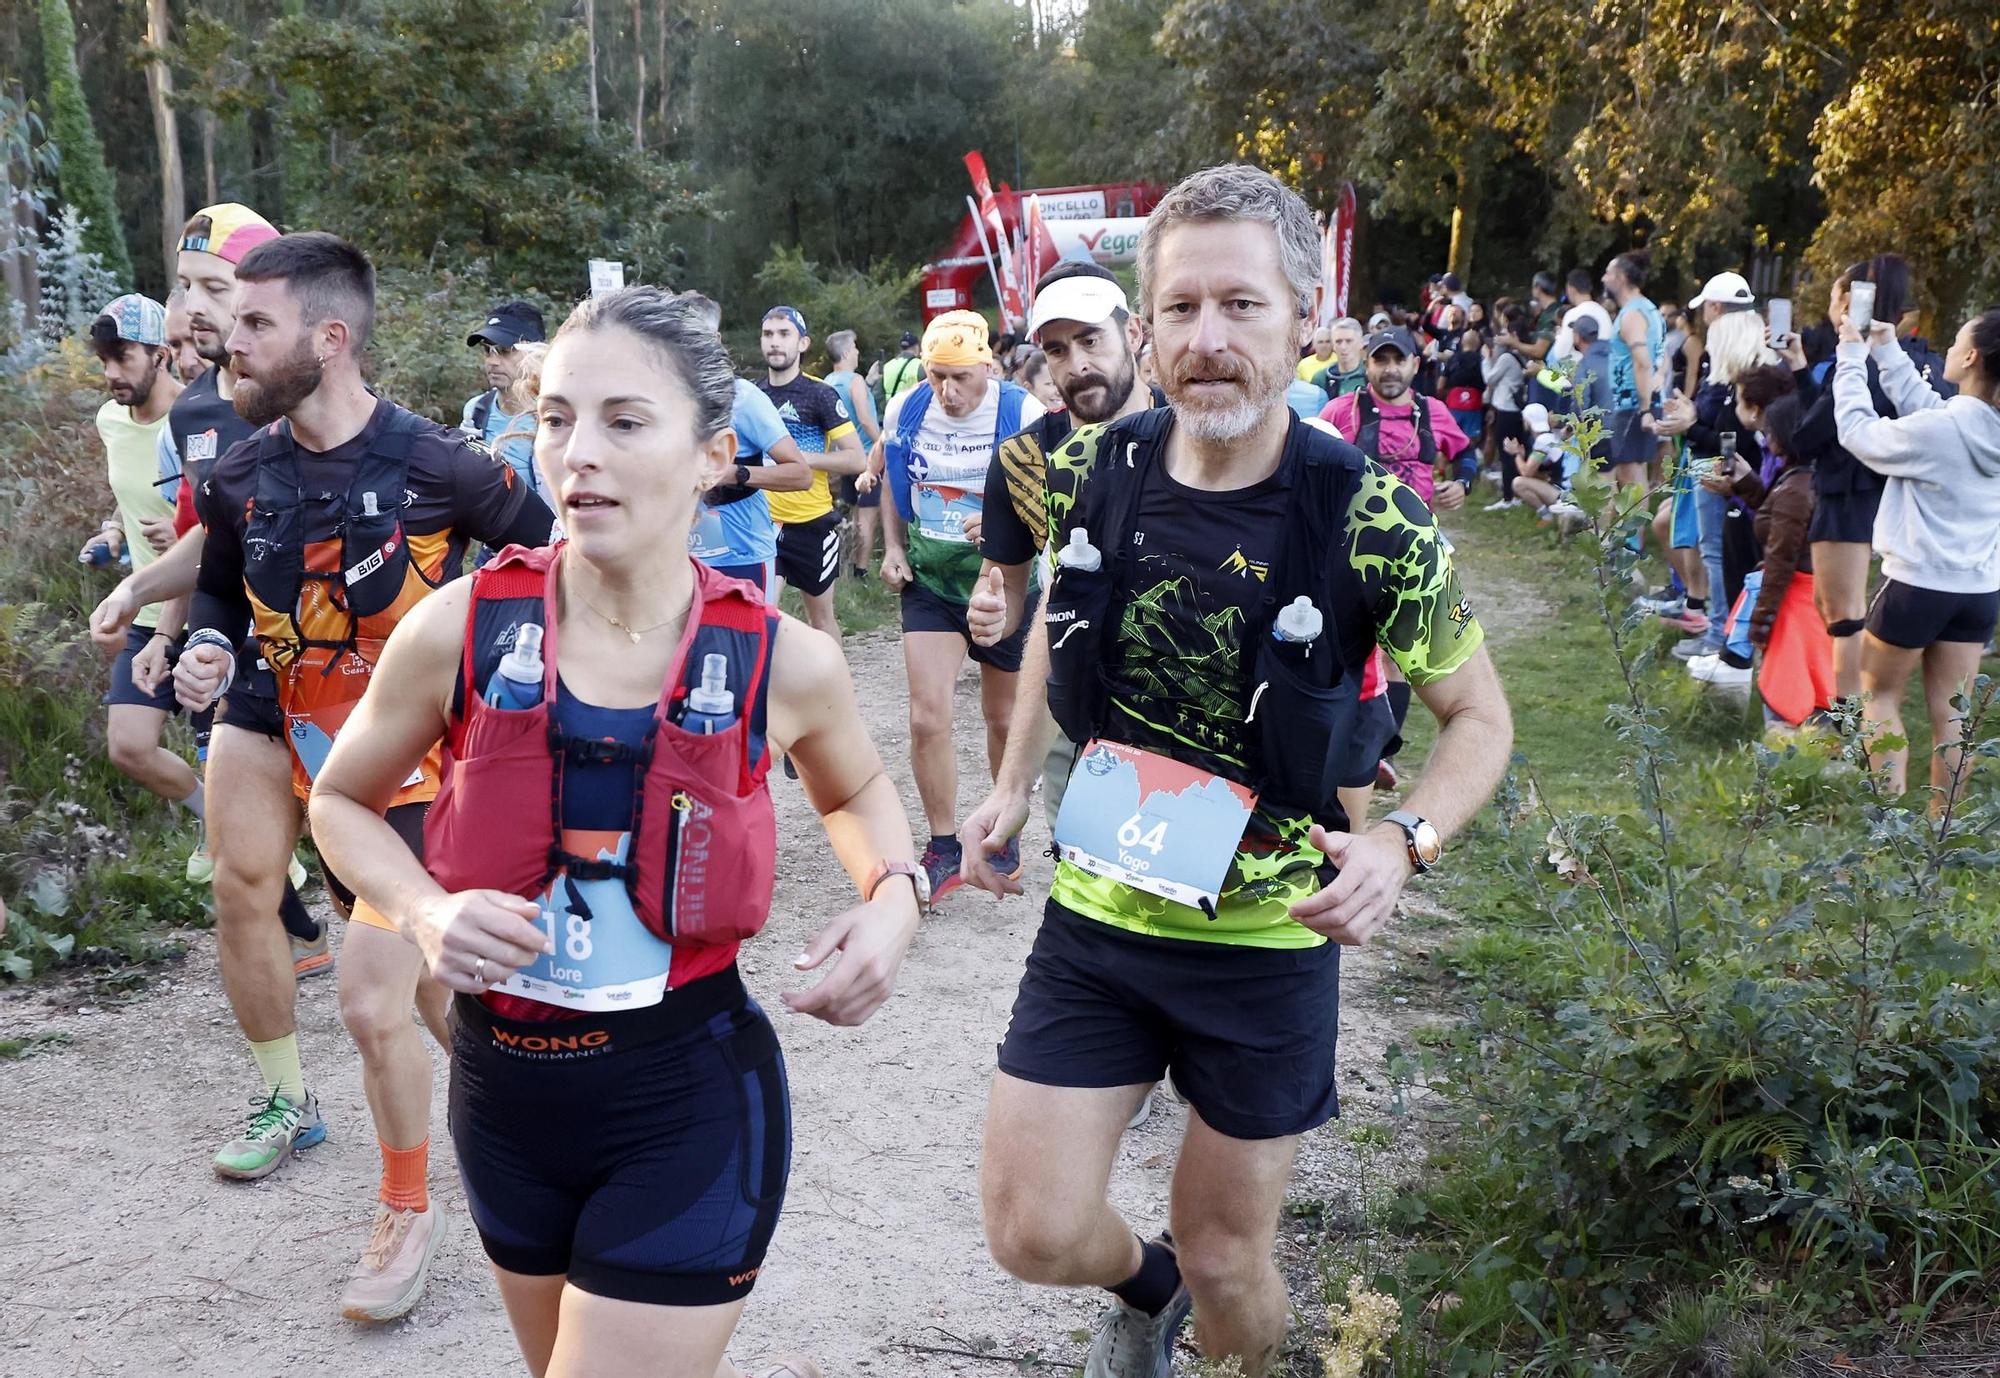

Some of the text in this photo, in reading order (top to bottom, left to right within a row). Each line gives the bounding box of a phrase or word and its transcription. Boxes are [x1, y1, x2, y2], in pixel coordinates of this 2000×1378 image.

[1039, 199, 1098, 211] ONCELLO
[1079, 228, 1140, 255] Vega
[942, 510, 962, 526] 79
[358, 553, 381, 576] BIG
[1047, 609, 1076, 623] MON
[1117, 811, 1169, 855] 64
[1118, 848, 1150, 871] Yago
[542, 911, 593, 961] 18
[550, 960, 582, 983] Lore
[491, 1025, 609, 1051] WONG
[492, 1039, 614, 1061] PERFORMANCE
